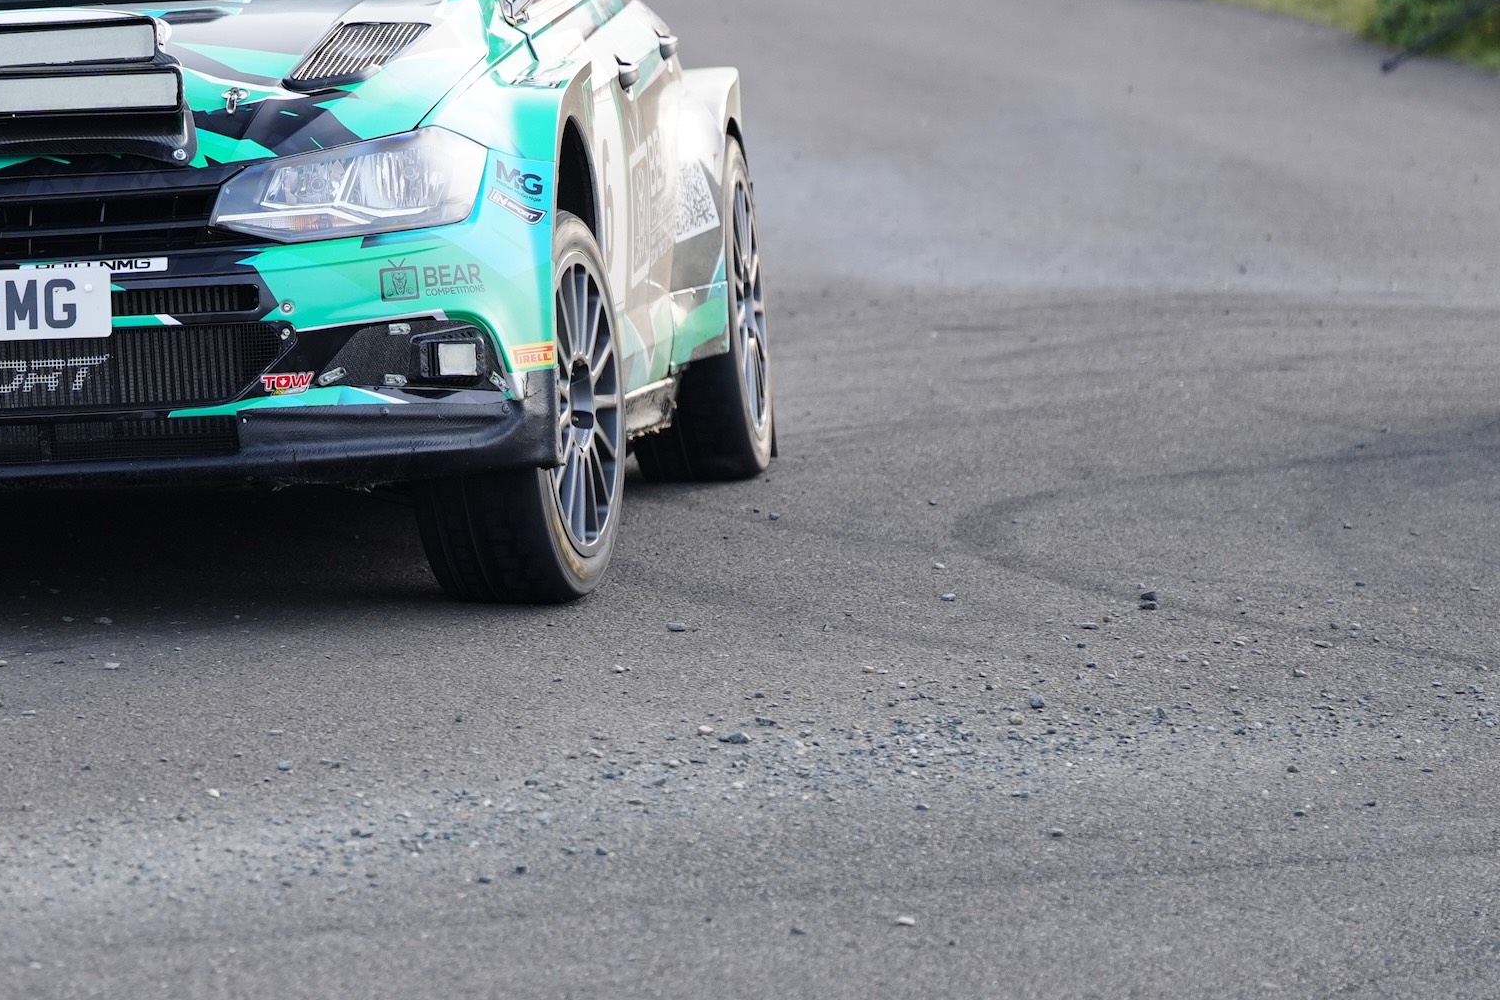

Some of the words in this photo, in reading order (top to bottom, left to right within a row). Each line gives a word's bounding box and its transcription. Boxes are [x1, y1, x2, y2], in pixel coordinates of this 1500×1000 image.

[423, 263, 484, 288] BEAR
[425, 285, 486, 297] COMPETITIONS
[262, 373, 313, 389] TOW
